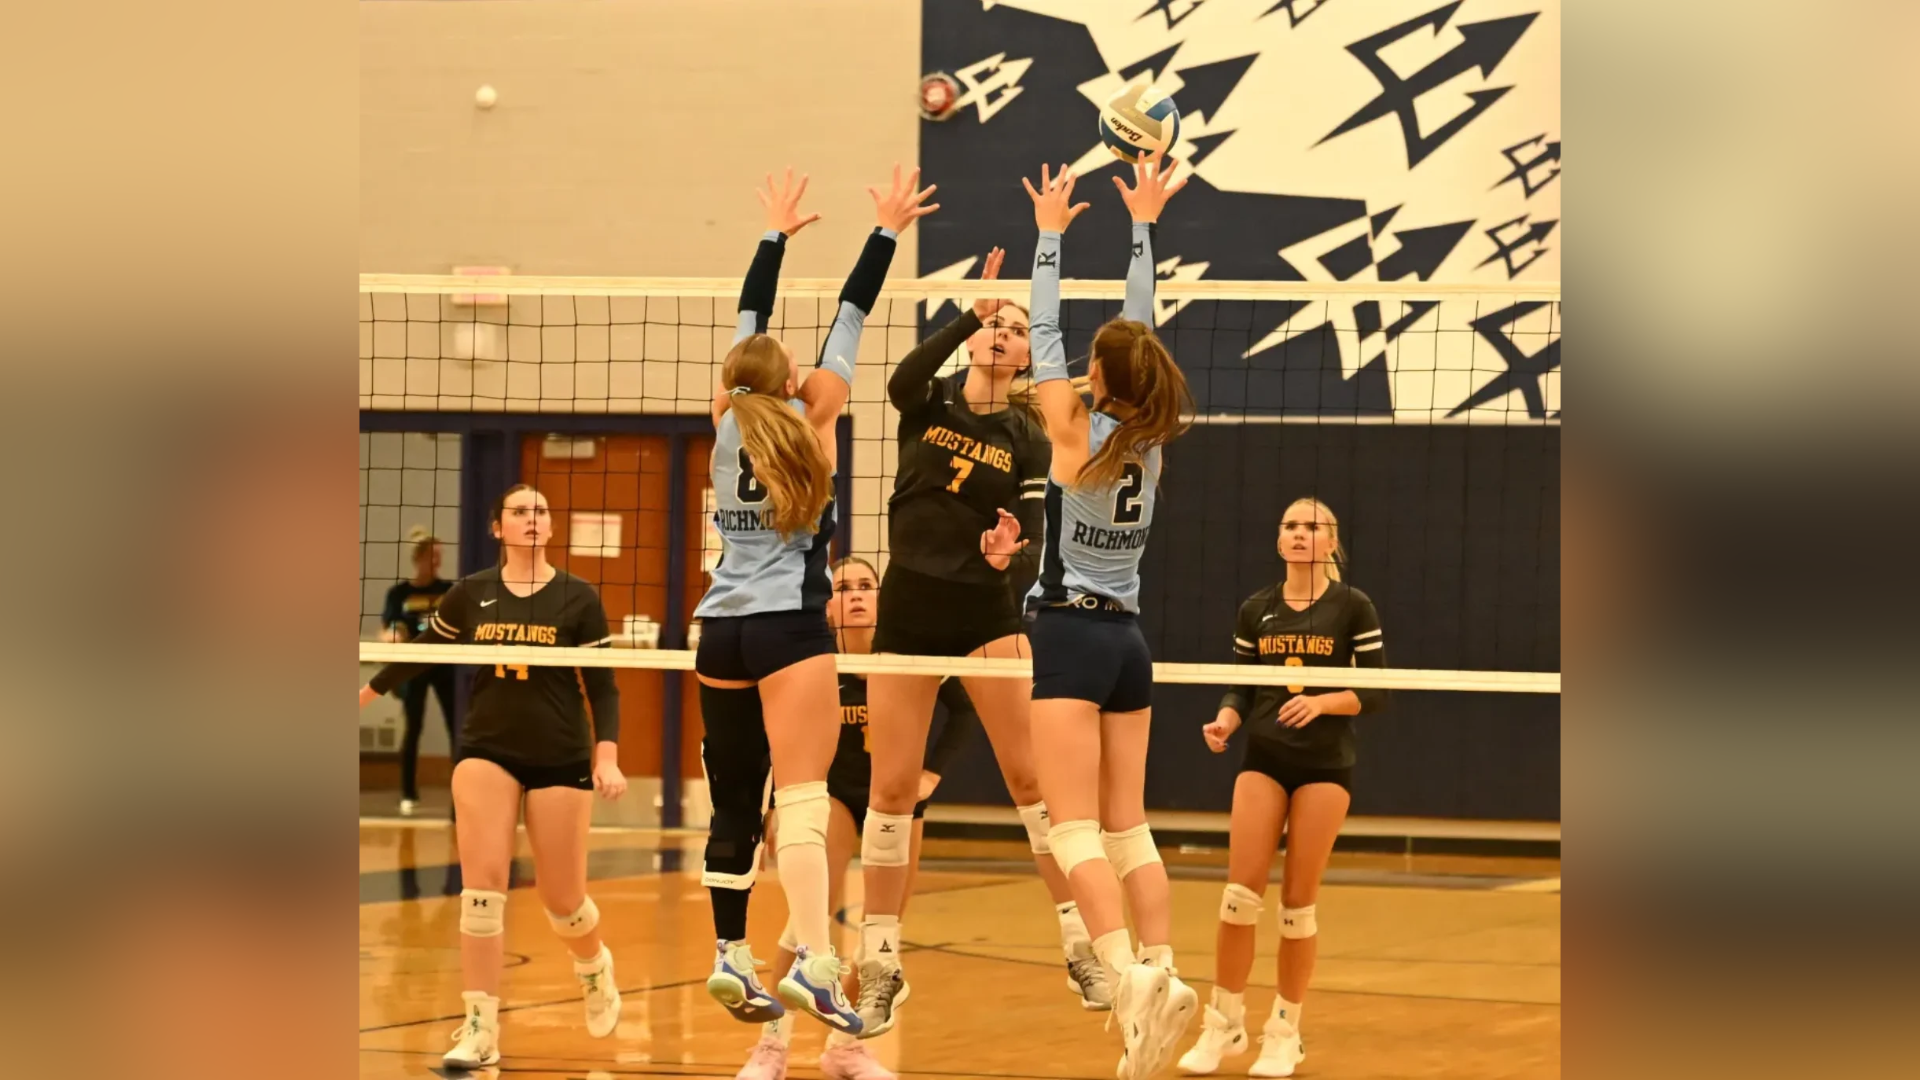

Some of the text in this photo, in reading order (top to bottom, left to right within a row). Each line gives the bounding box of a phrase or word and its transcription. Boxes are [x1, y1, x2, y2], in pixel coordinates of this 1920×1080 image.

[1110, 117, 1143, 143] Baden
[1036, 250, 1057, 269] R
[922, 425, 1012, 473] MUSTANGS
[946, 455, 975, 494] 7
[1112, 461, 1145, 526] 2
[475, 623, 557, 645] MUSTANGS
[1258, 634, 1335, 656] MUSTANGS
